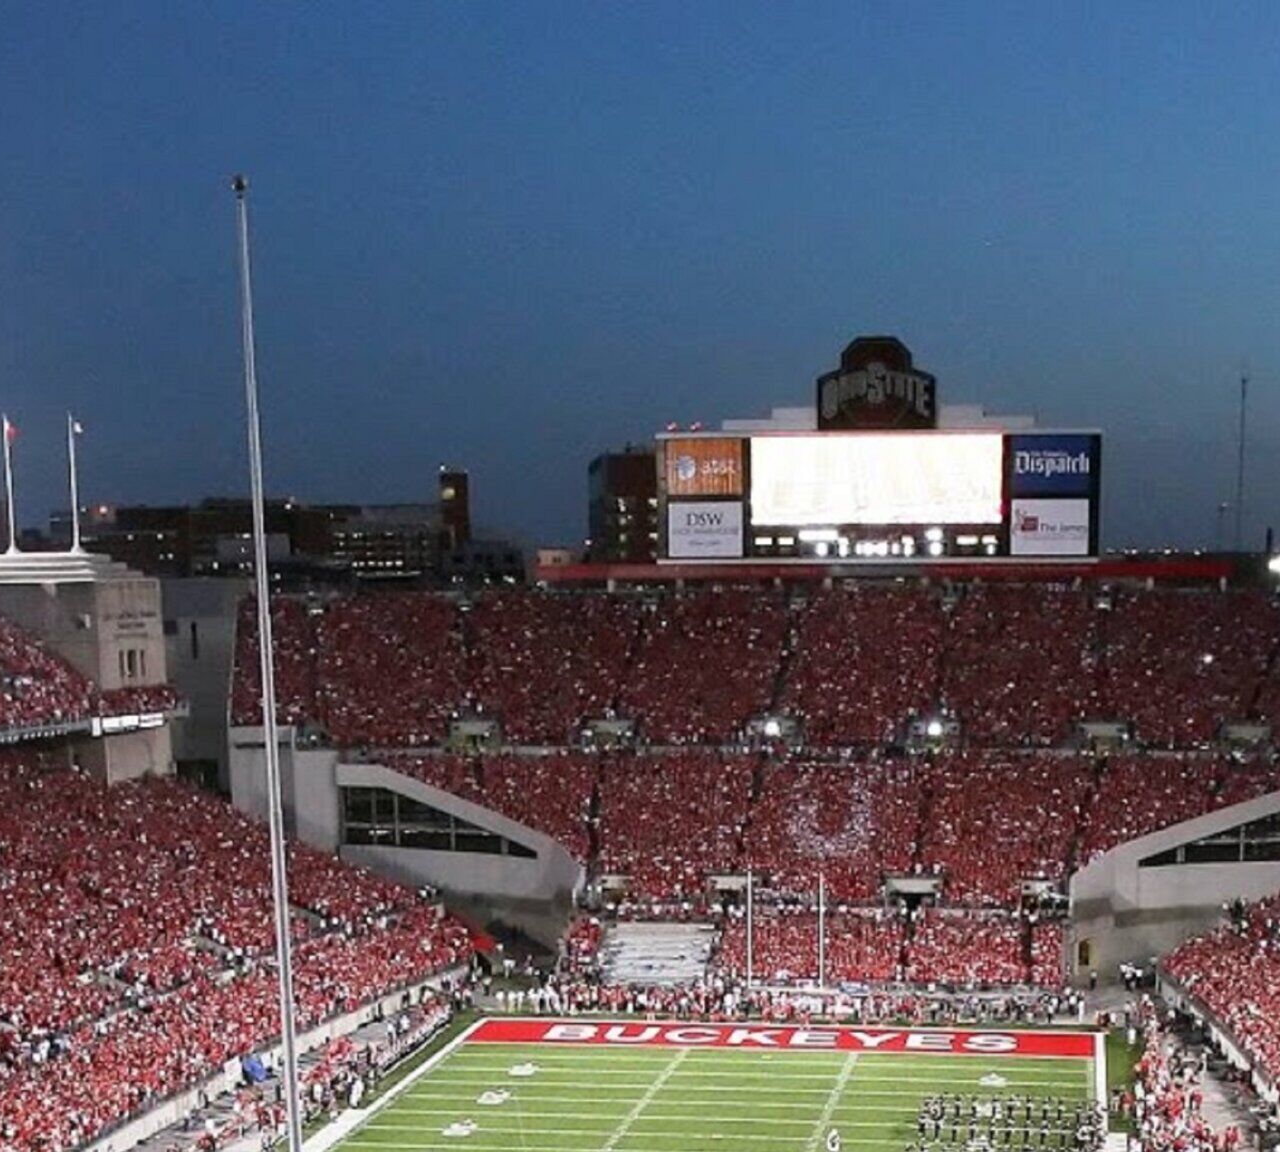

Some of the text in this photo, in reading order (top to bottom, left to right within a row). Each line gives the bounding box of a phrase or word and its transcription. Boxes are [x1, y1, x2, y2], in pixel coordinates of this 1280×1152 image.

[1014, 450, 1090, 477] Dispatch
[686, 511, 724, 527] DSW
[542, 1022, 1019, 1054] BUCKEYES
